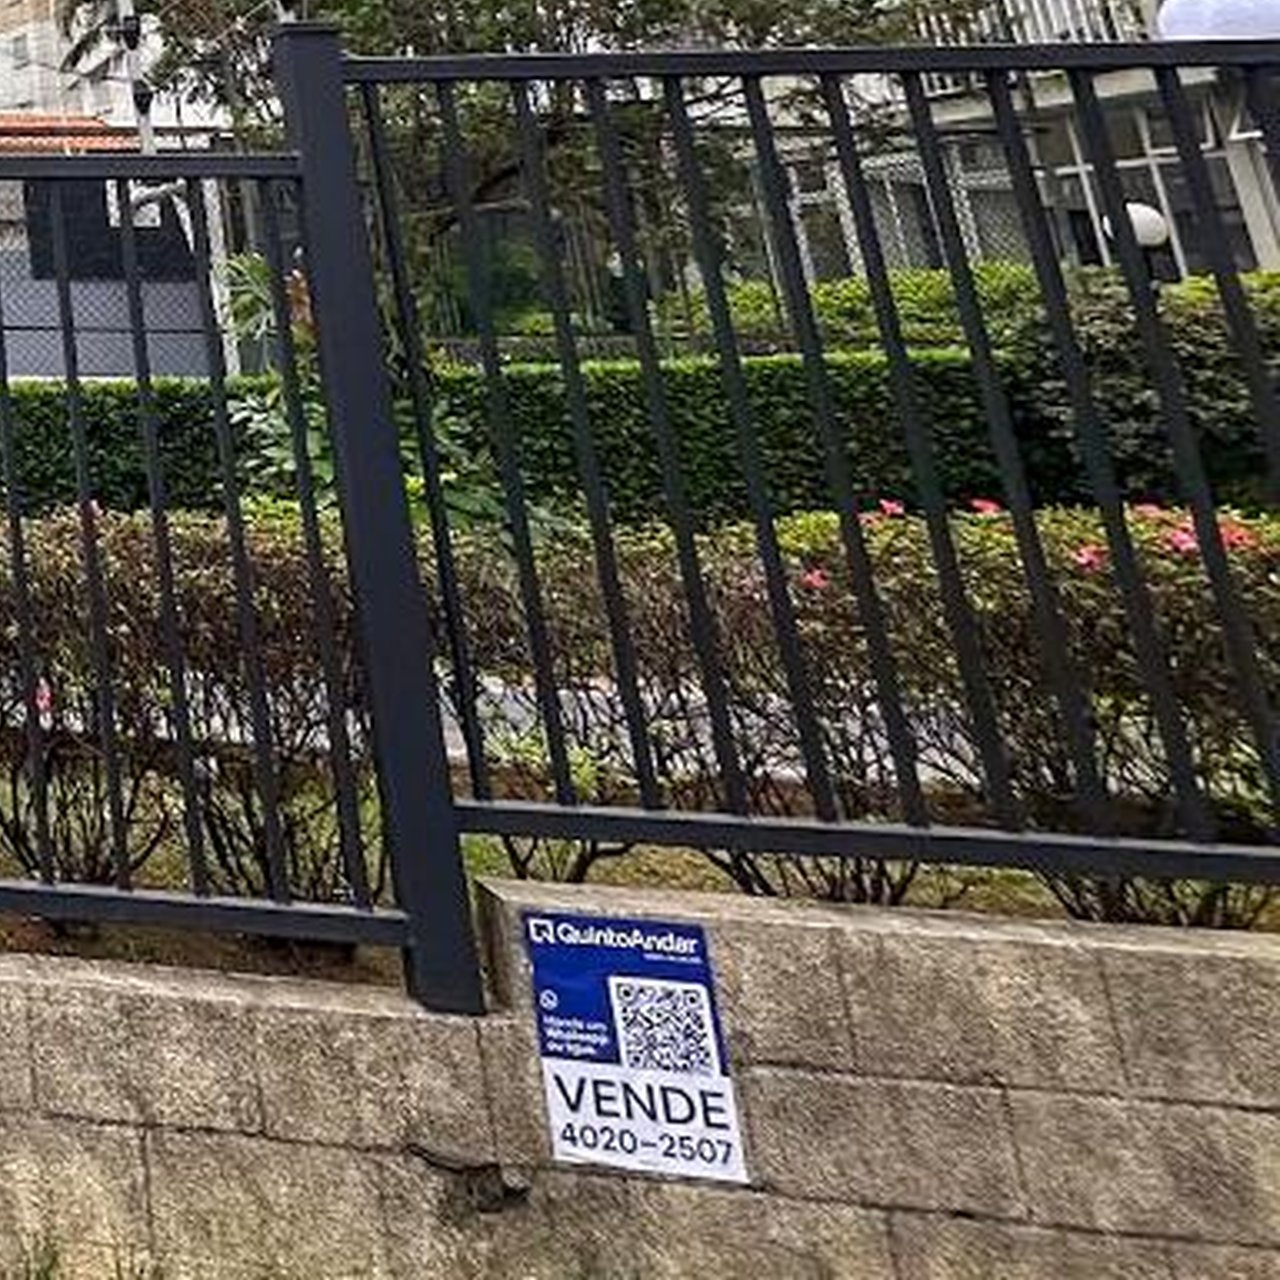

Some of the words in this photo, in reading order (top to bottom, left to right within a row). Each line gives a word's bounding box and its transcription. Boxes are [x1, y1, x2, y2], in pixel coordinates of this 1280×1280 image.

[557, 922, 699, 954] QuintoAndar
[554, 1074, 731, 1131] VENDE
[560, 1122, 732, 1165] 4020-2507
